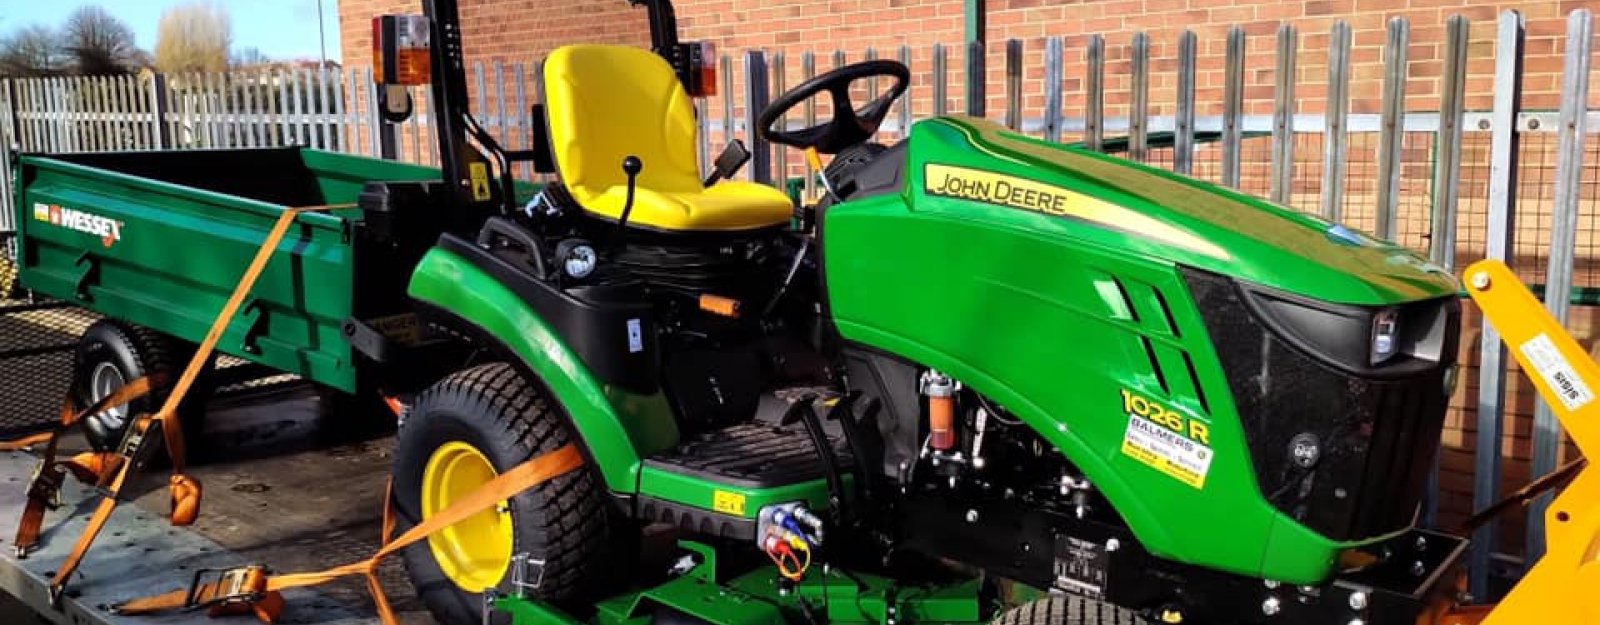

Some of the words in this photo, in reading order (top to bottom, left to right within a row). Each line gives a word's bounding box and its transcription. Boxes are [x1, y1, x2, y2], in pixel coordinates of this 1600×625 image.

[936, 173, 991, 198] JOHN
[994, 180, 1067, 213] DEERE
[61, 206, 122, 246] WESSEX
[1121, 389, 1184, 433] 1026
[1187, 418, 1210, 447] R
[1131, 418, 1194, 452] BALMERS
